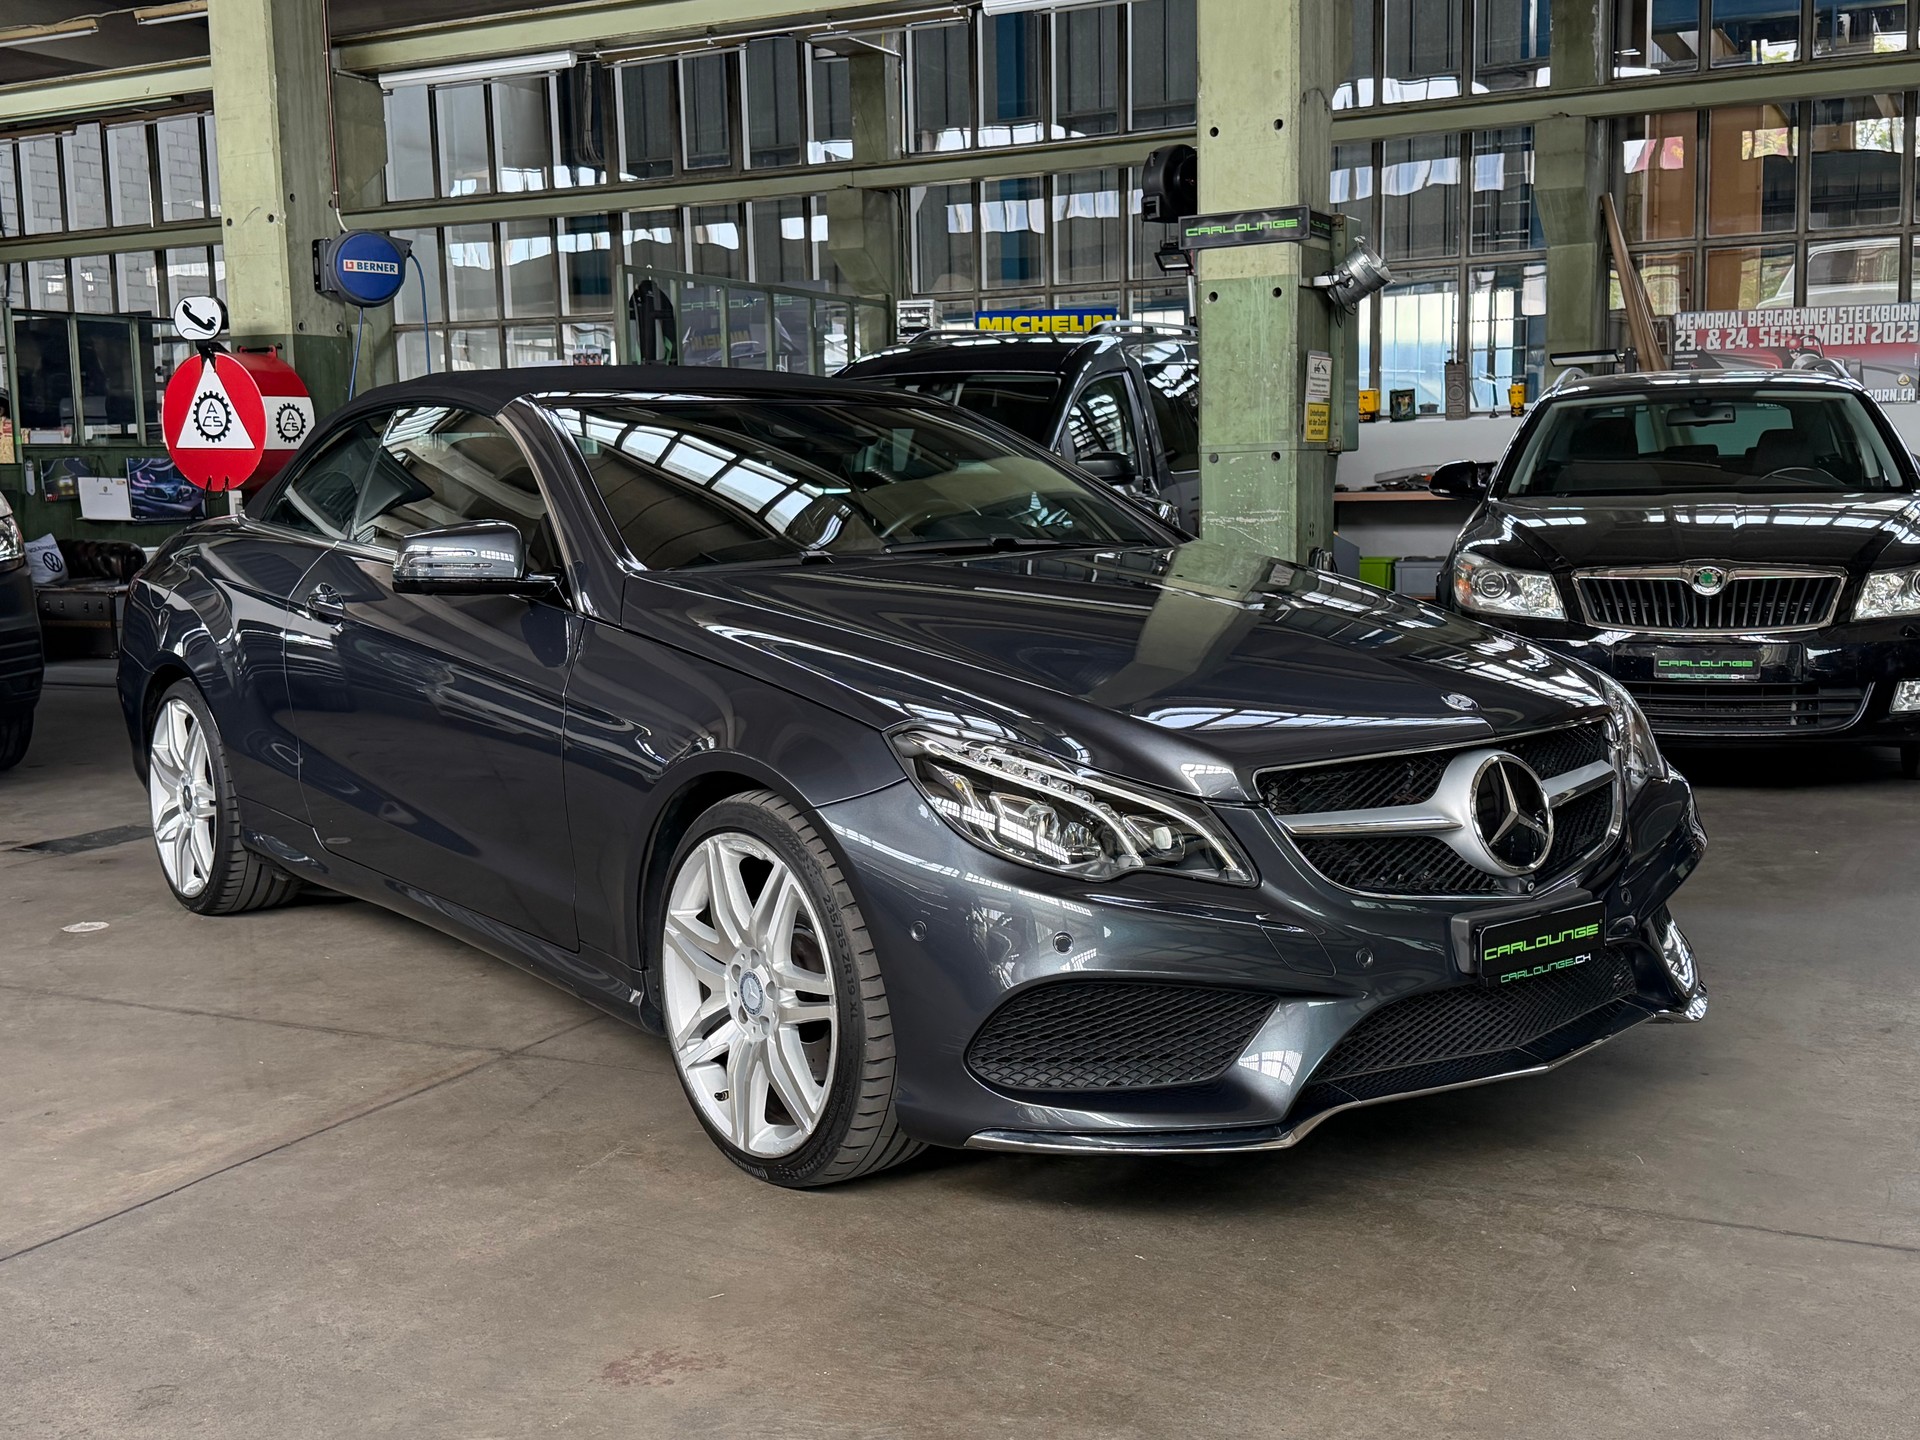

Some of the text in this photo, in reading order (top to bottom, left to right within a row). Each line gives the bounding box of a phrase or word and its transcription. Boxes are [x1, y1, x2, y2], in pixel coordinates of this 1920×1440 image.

[1186, 219, 1298, 237] CARLOUNGE
[356, 261, 396, 273] BERNER
[1675, 303, 1920, 331] MEMORIAL BERGRENNEN STECKBORN
[1674, 321, 1919, 352] 23. & 24. SEPTEMBER 2023
[1484, 923, 1599, 961] CARLOUNGE
[823, 895, 858, 1022] 235/35 ZR 19 XL
[1500, 953, 1591, 984] CARLOUNGE.CH
